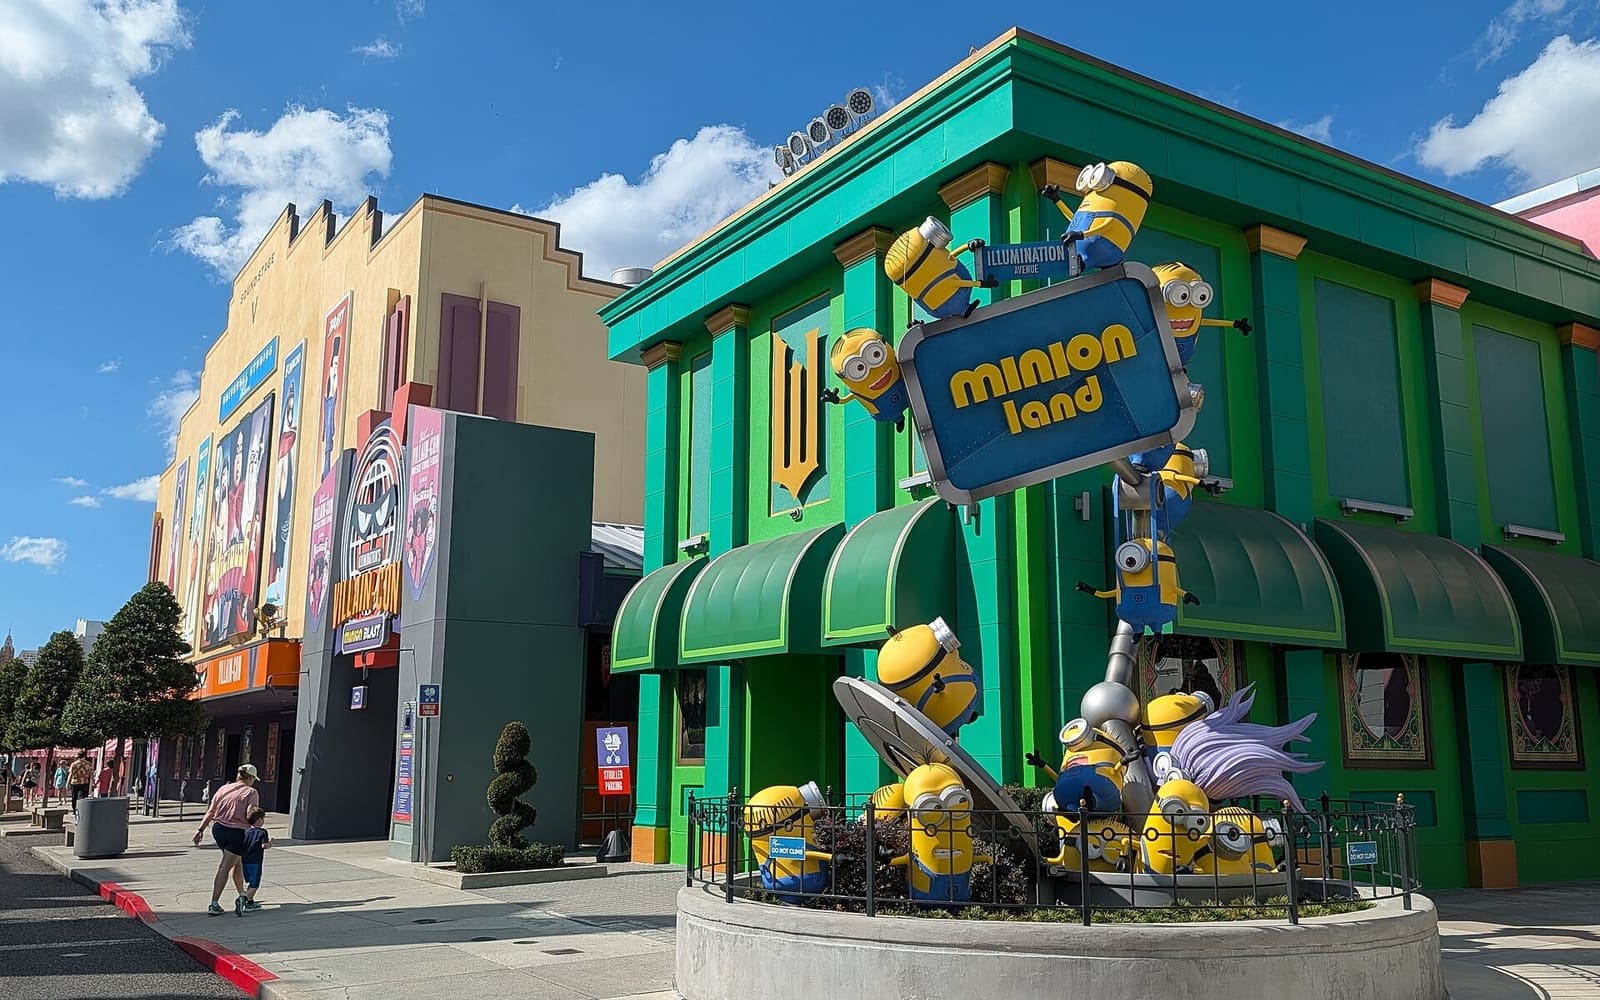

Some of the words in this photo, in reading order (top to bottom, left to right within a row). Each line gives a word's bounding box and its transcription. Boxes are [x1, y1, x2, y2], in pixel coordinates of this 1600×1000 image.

[240, 251, 275, 305] SOUNDSTAGE
[987, 245, 1065, 267] ILLUMINATION
[1014, 263, 1039, 275] AVENUE
[950, 323, 1137, 409] minion
[1002, 374, 1103, 435] land
[332, 559, 402, 631] VILLAIN-CON
[363, 623, 382, 641] BLAST
